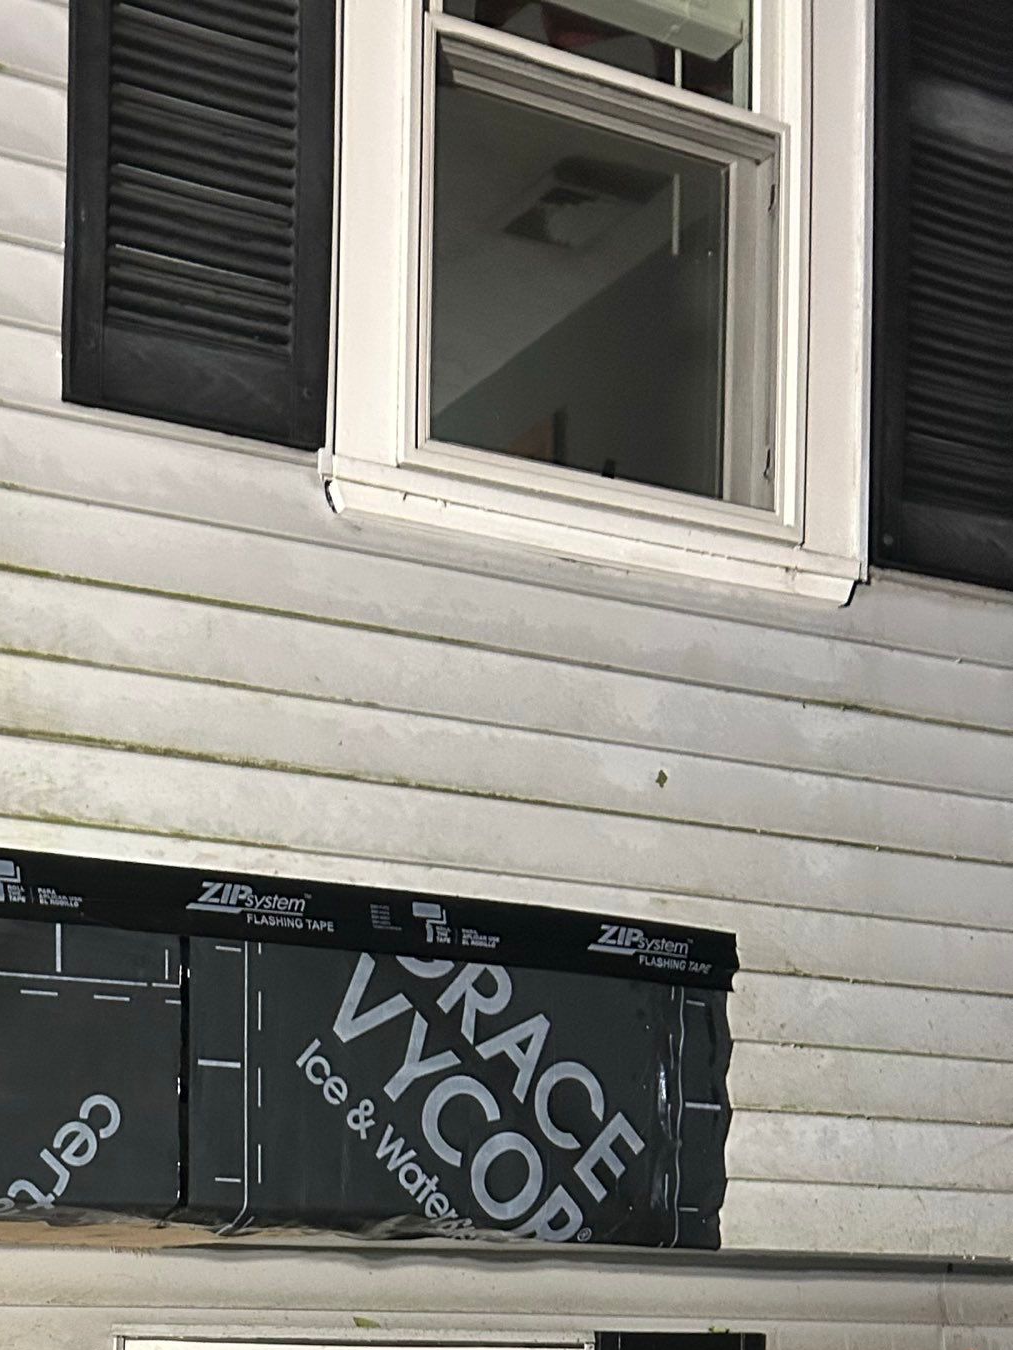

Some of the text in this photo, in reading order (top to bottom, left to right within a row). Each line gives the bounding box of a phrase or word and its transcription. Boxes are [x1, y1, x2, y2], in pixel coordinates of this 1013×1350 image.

[246, 914, 335, 932] FLASHING TAPE
[638, 954, 713, 974] FLASHING TAPE
[295, 1039, 349, 1106] Ice
[347, 1098, 376, 1140] &
